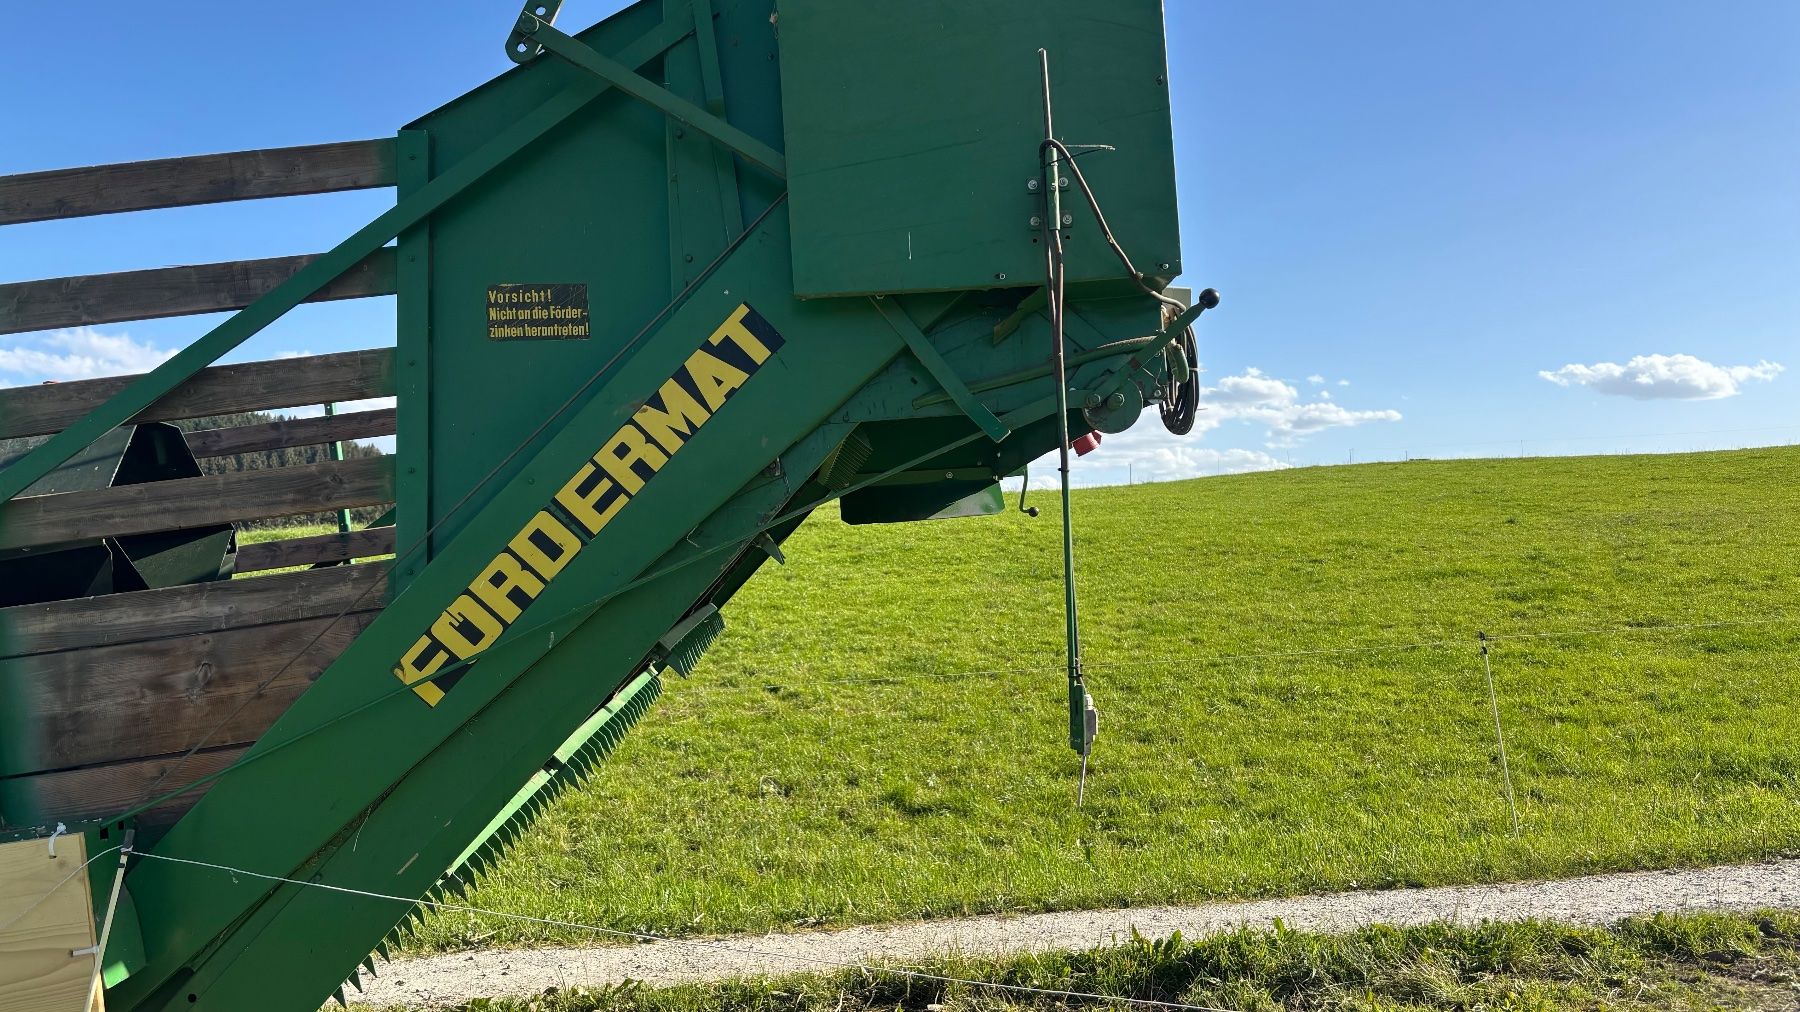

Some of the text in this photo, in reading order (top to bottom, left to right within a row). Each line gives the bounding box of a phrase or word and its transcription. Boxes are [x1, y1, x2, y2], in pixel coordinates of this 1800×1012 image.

[488, 289, 552, 303] Vorsicht!
[489, 305, 588, 321] Nicht an die Förder-
[489, 322, 590, 338] zinken herantreten!
